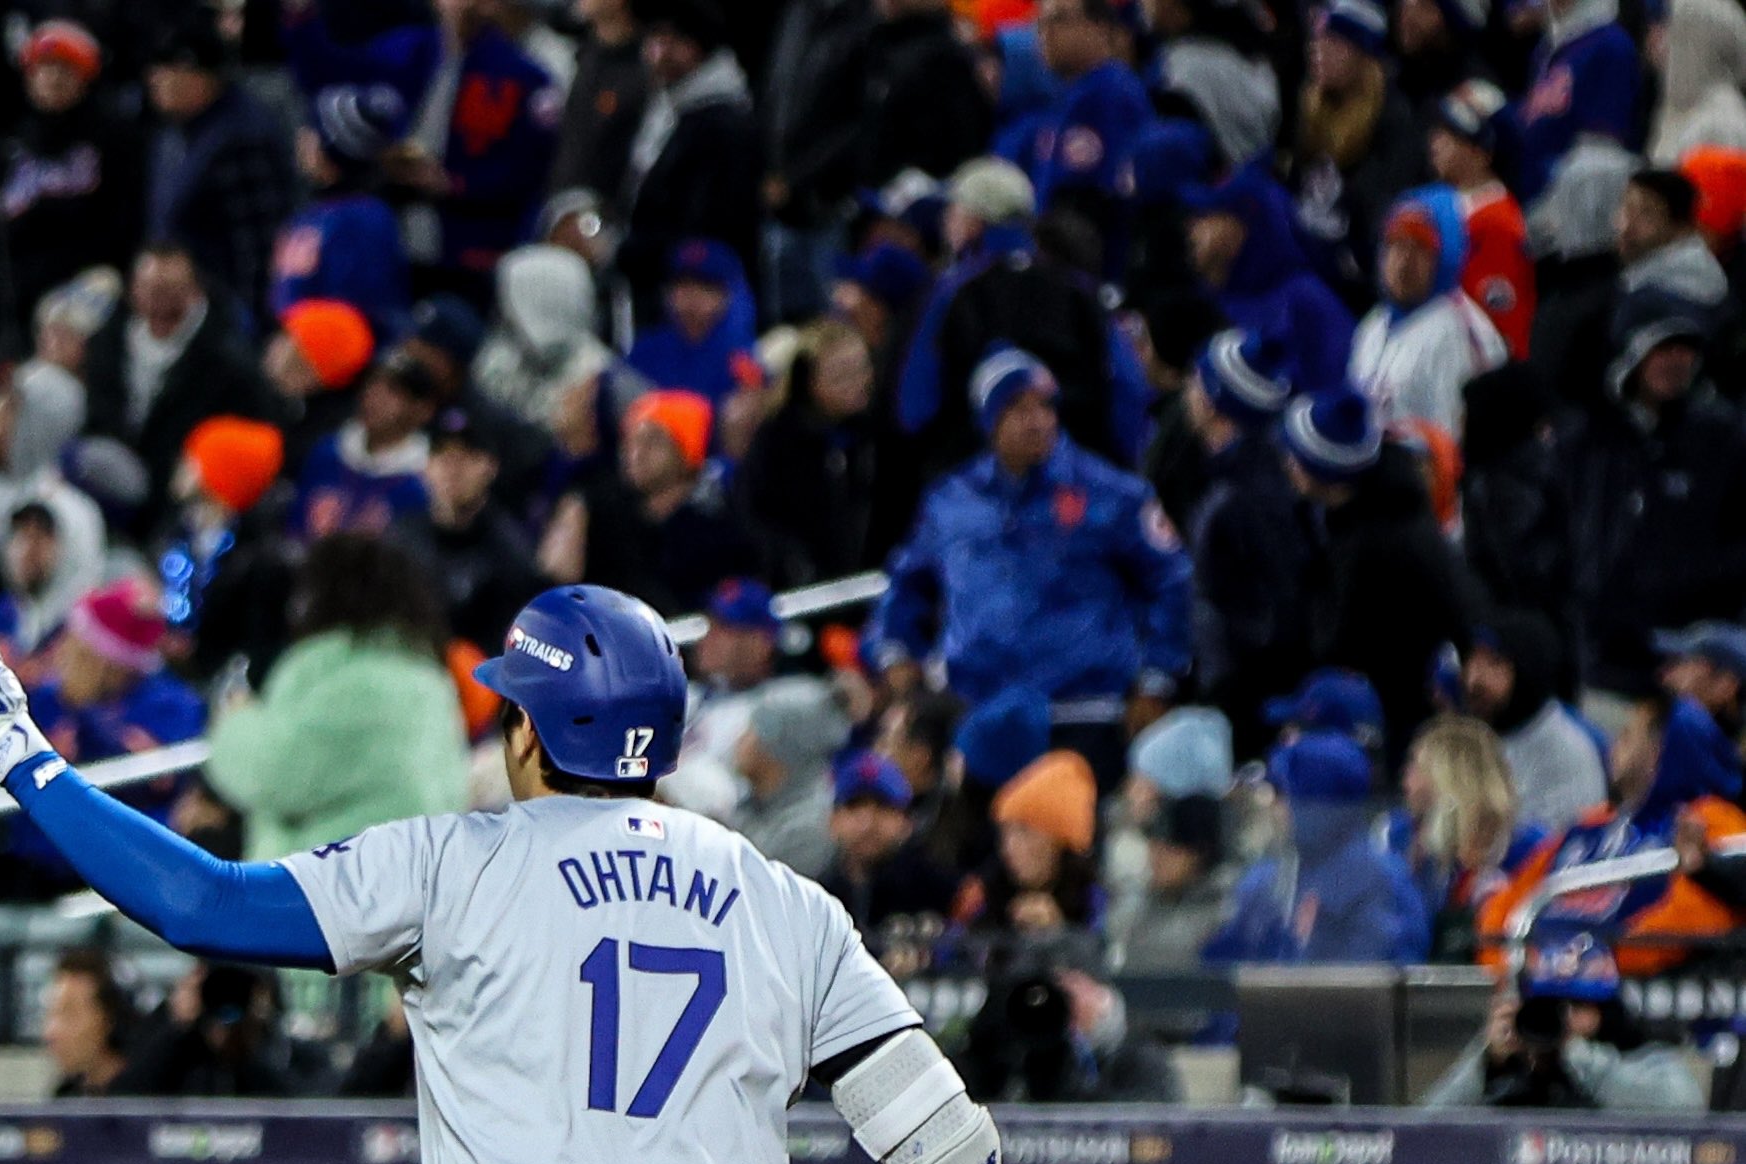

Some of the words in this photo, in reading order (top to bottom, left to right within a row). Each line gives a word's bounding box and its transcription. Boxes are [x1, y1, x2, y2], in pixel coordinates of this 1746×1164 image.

[513, 628, 575, 672] STRAUSS
[624, 727, 654, 757] 17
[558, 850, 740, 927] OHTANI
[580, 936, 728, 1119] 17
